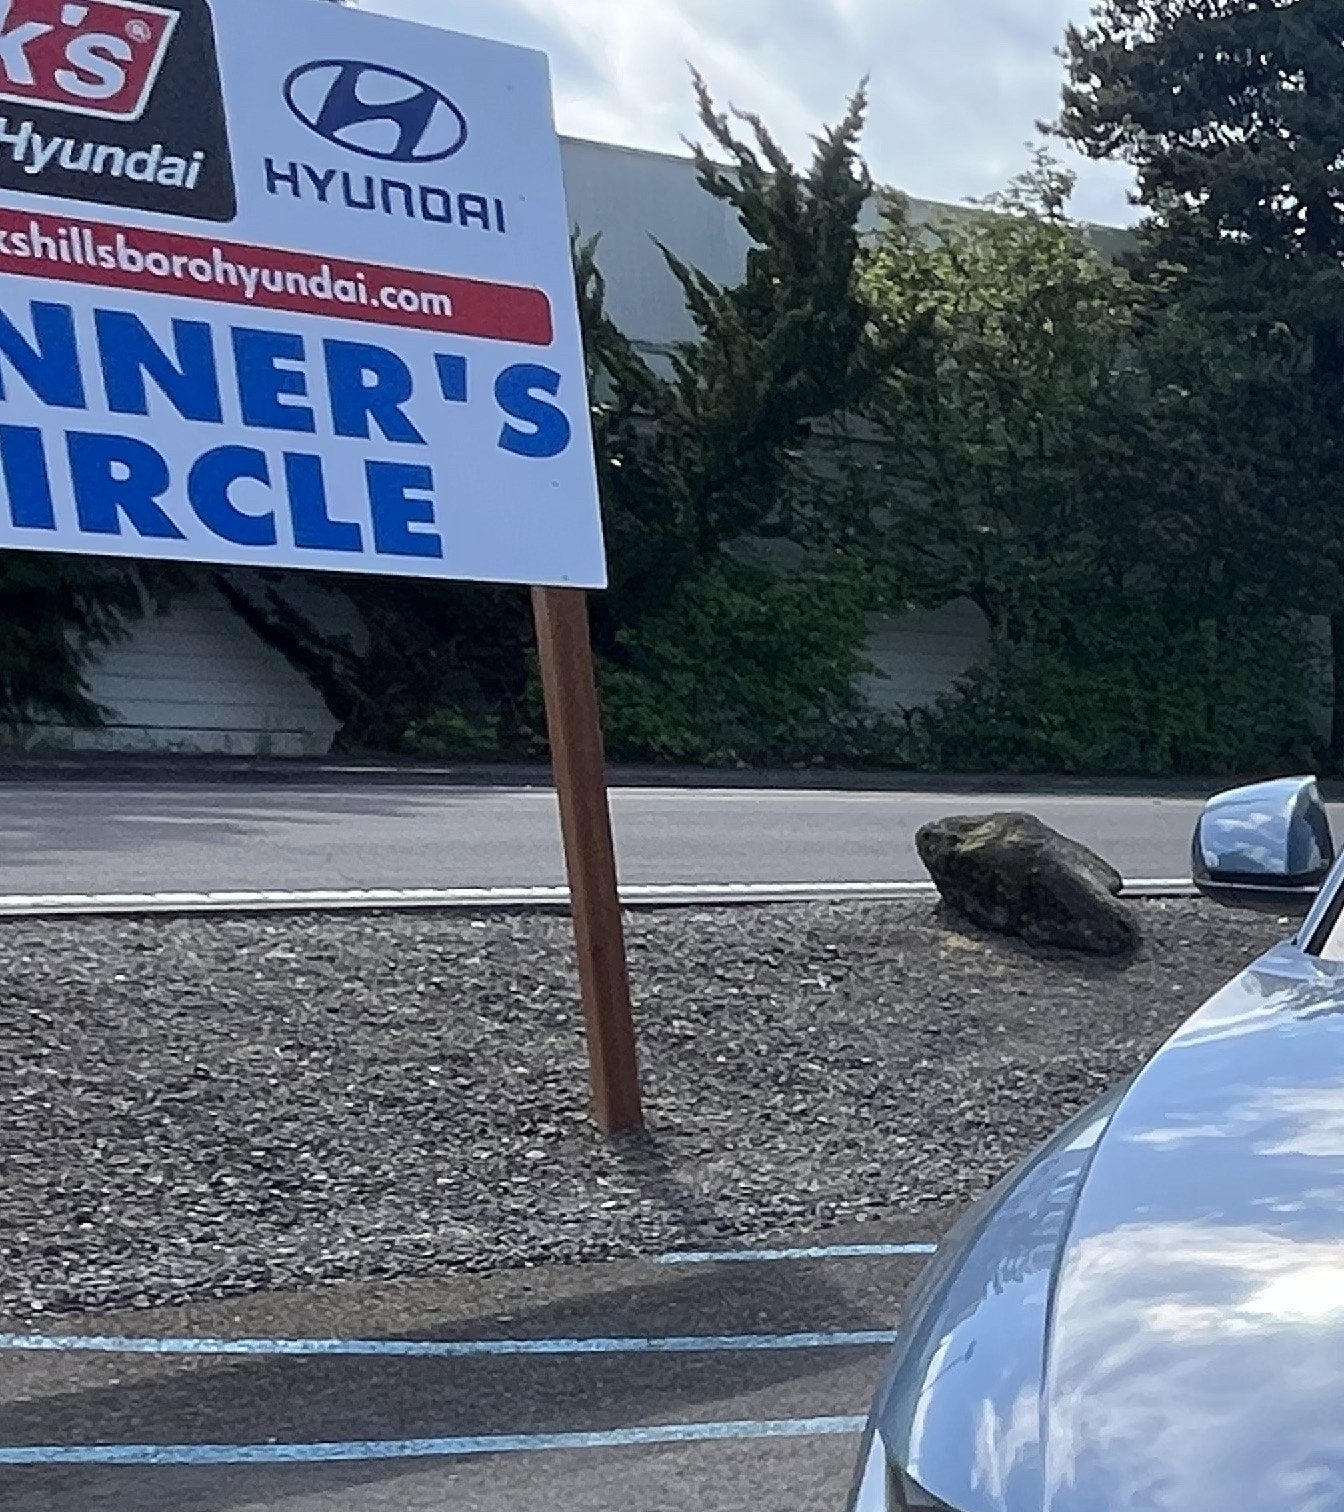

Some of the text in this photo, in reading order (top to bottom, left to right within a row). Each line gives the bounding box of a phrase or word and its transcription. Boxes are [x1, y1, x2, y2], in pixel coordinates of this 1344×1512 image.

[0, 117, 206, 190] Hyundai
[265, 158, 506, 234] HYUNDAI
[0, 300, 572, 458] NNER'S
[0, 425, 444, 558] IRCLE
